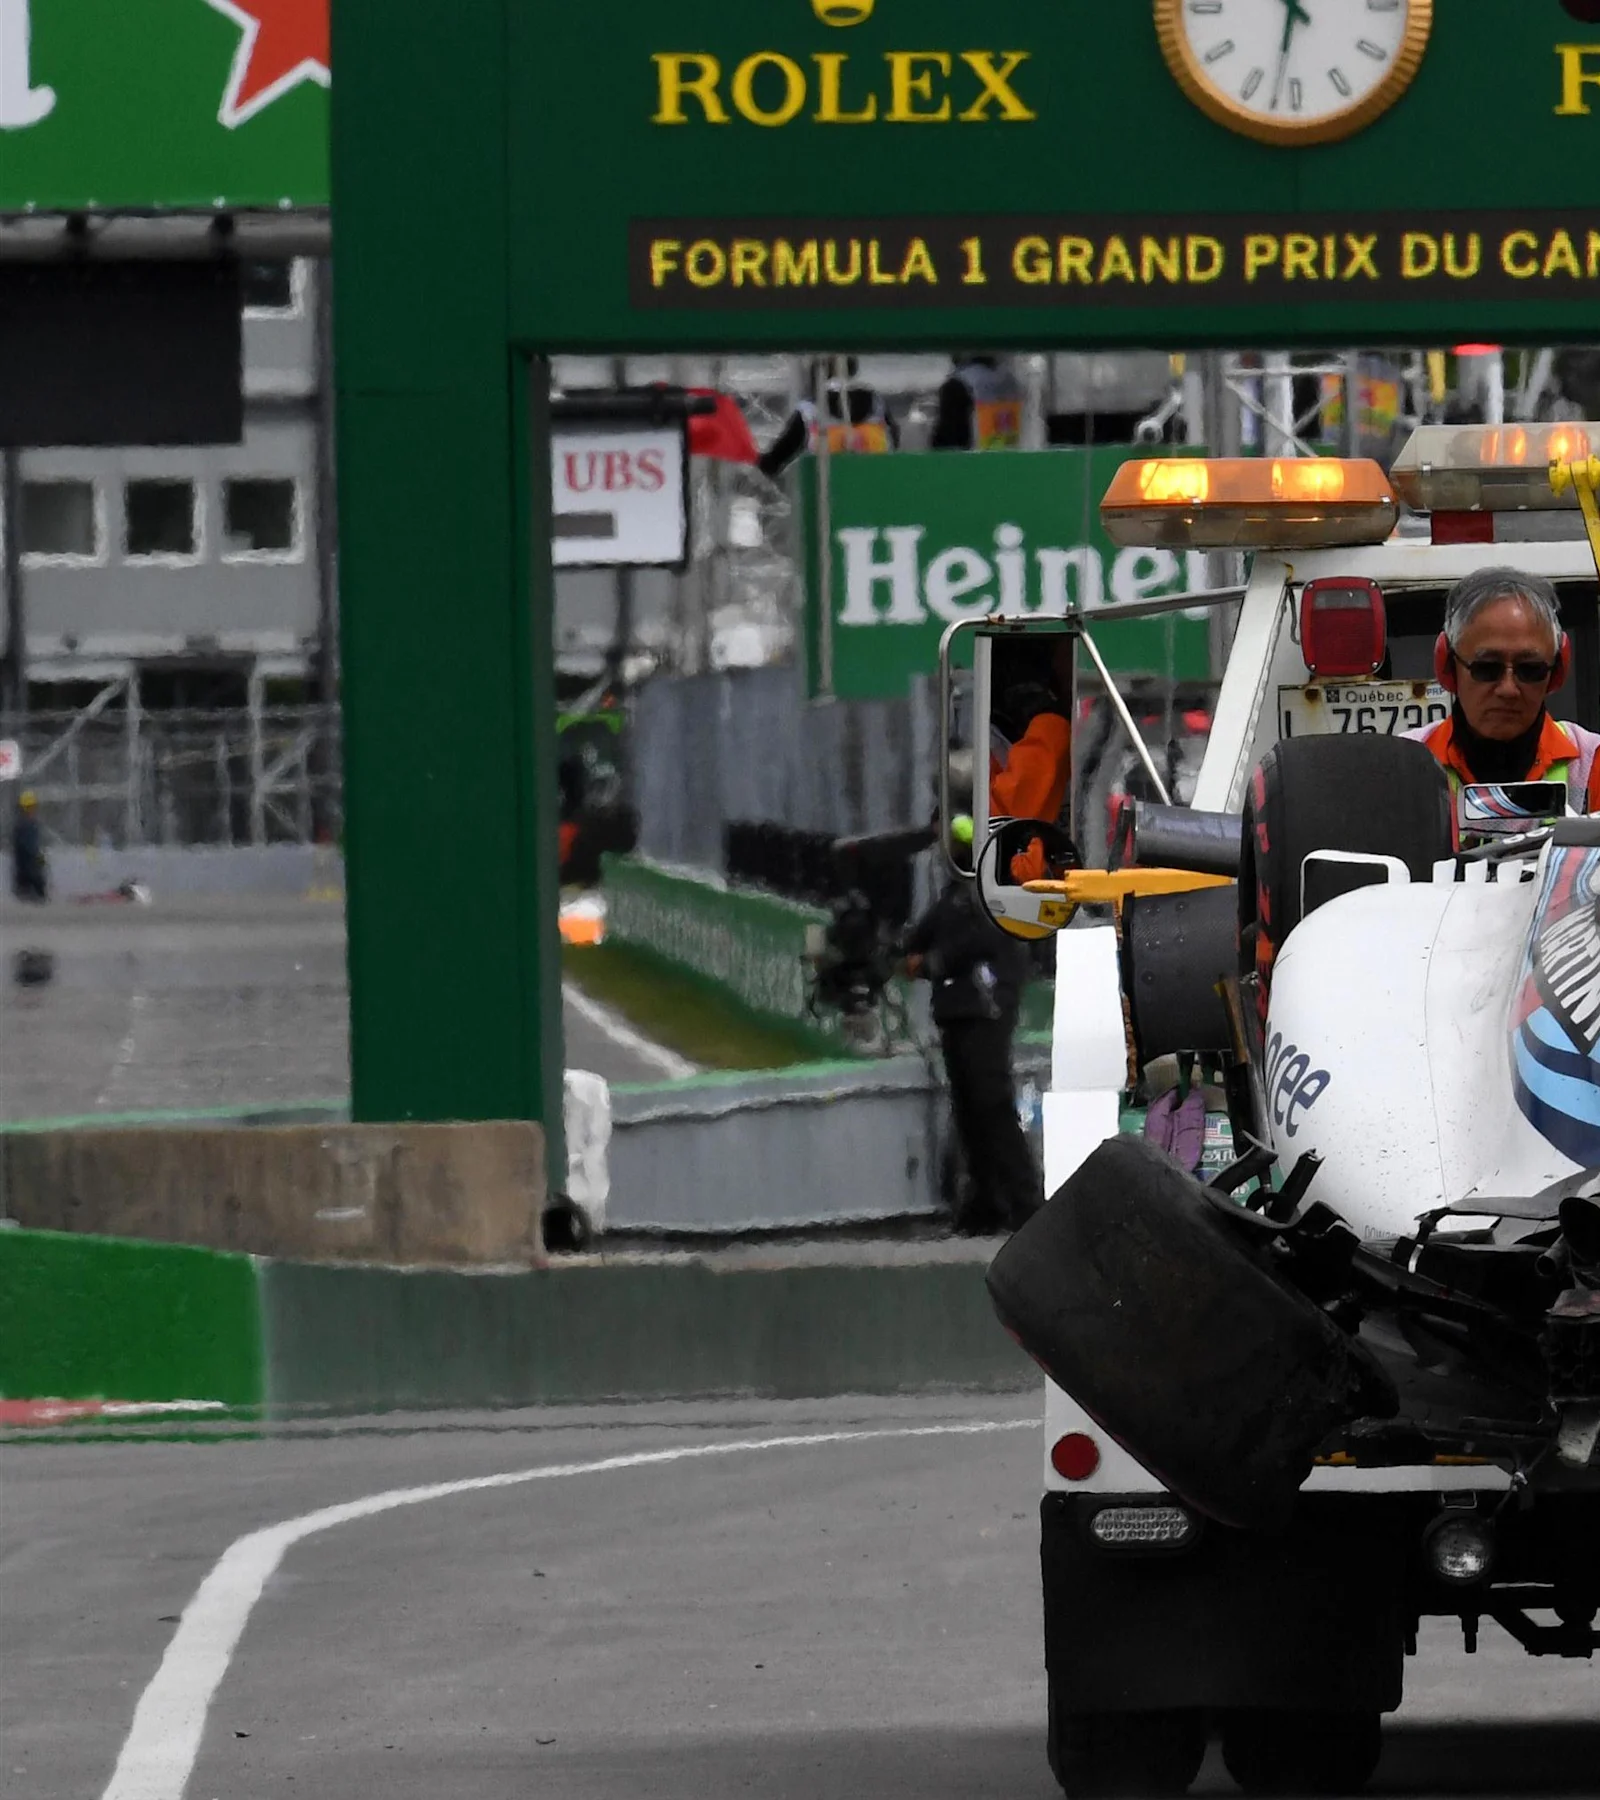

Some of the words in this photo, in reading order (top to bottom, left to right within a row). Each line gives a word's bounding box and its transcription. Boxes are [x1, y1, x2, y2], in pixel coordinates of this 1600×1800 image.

[651, 51, 1036, 126] ROLEX
[650, 238, 937, 288] FORMULA
[961, 236, 987, 284] 1
[1011, 234, 1224, 284] GRAND
[1243, 232, 1380, 281] PRIX
[1400, 231, 1481, 279] DU
[563, 448, 666, 493] UBS
[1345, 690, 1404, 704] Québec
